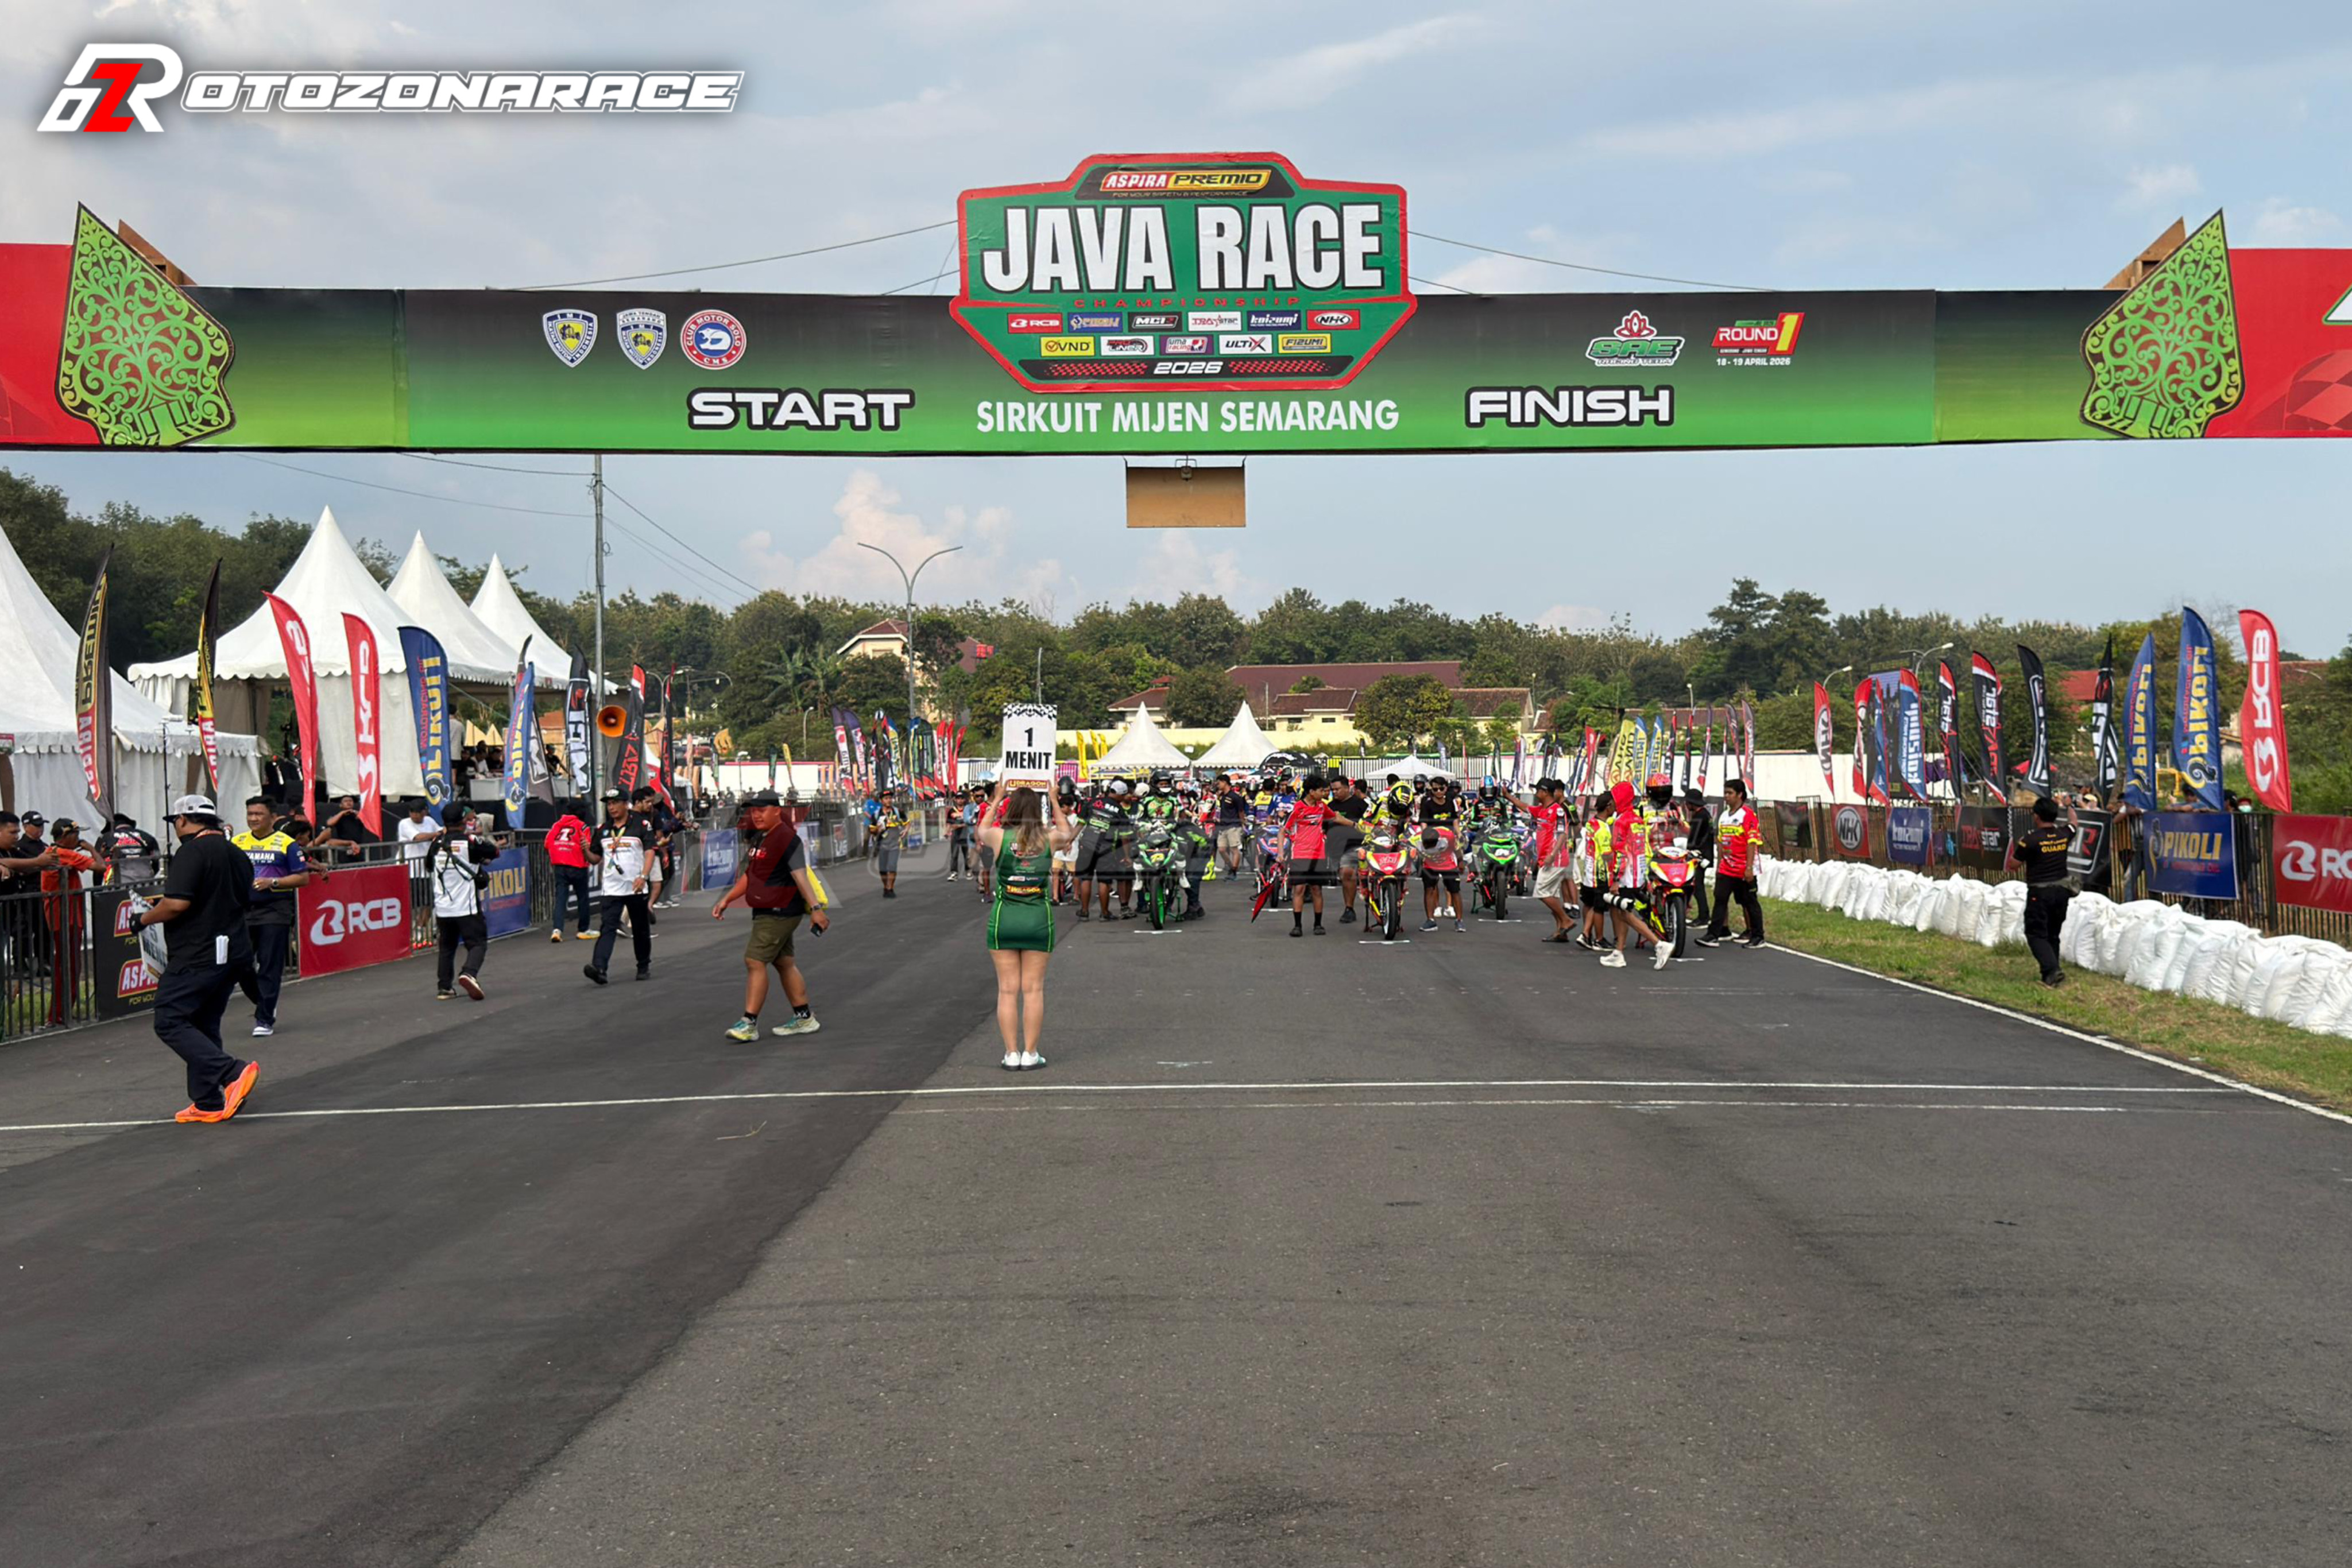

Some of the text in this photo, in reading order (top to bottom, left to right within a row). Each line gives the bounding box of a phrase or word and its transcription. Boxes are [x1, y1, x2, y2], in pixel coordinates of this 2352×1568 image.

[1105, 173, 1263, 188] ASPIRA PREMIO
[982, 203, 1382, 292] JAVA RACE
[1074, 296, 1301, 308] CHAMPIONSHIP
[687, 315, 741, 346] CLUB MOTOR SOLO
[1718, 315, 1799, 351] ROUND 1
[1058, 342, 1090, 352] VND
[1591, 339, 1678, 356] SAE
[1153, 361, 1224, 374] 2026
[1733, 358, 1742, 366] 19
[1744, 358, 1768, 366] APRIL
[1770, 357, 1791, 365] 2026
[691, 391, 912, 428] START
[977, 399, 1401, 433] SIRKUIT MIJEN SEMARANG
[1468, 388, 1672, 424] FINISH
[1024, 727, 1034, 747] 1
[1005, 750, 1052, 770] MENIT
[1839, 817, 1858, 842] NHK
[246, 852, 275, 861] YAMAHA
[2041, 843, 2067, 853] GUARD
[2163, 831, 2223, 861] PIKOLI
[2321, 847, 2352, 879] RC
[348, 897, 401, 934] RCB
